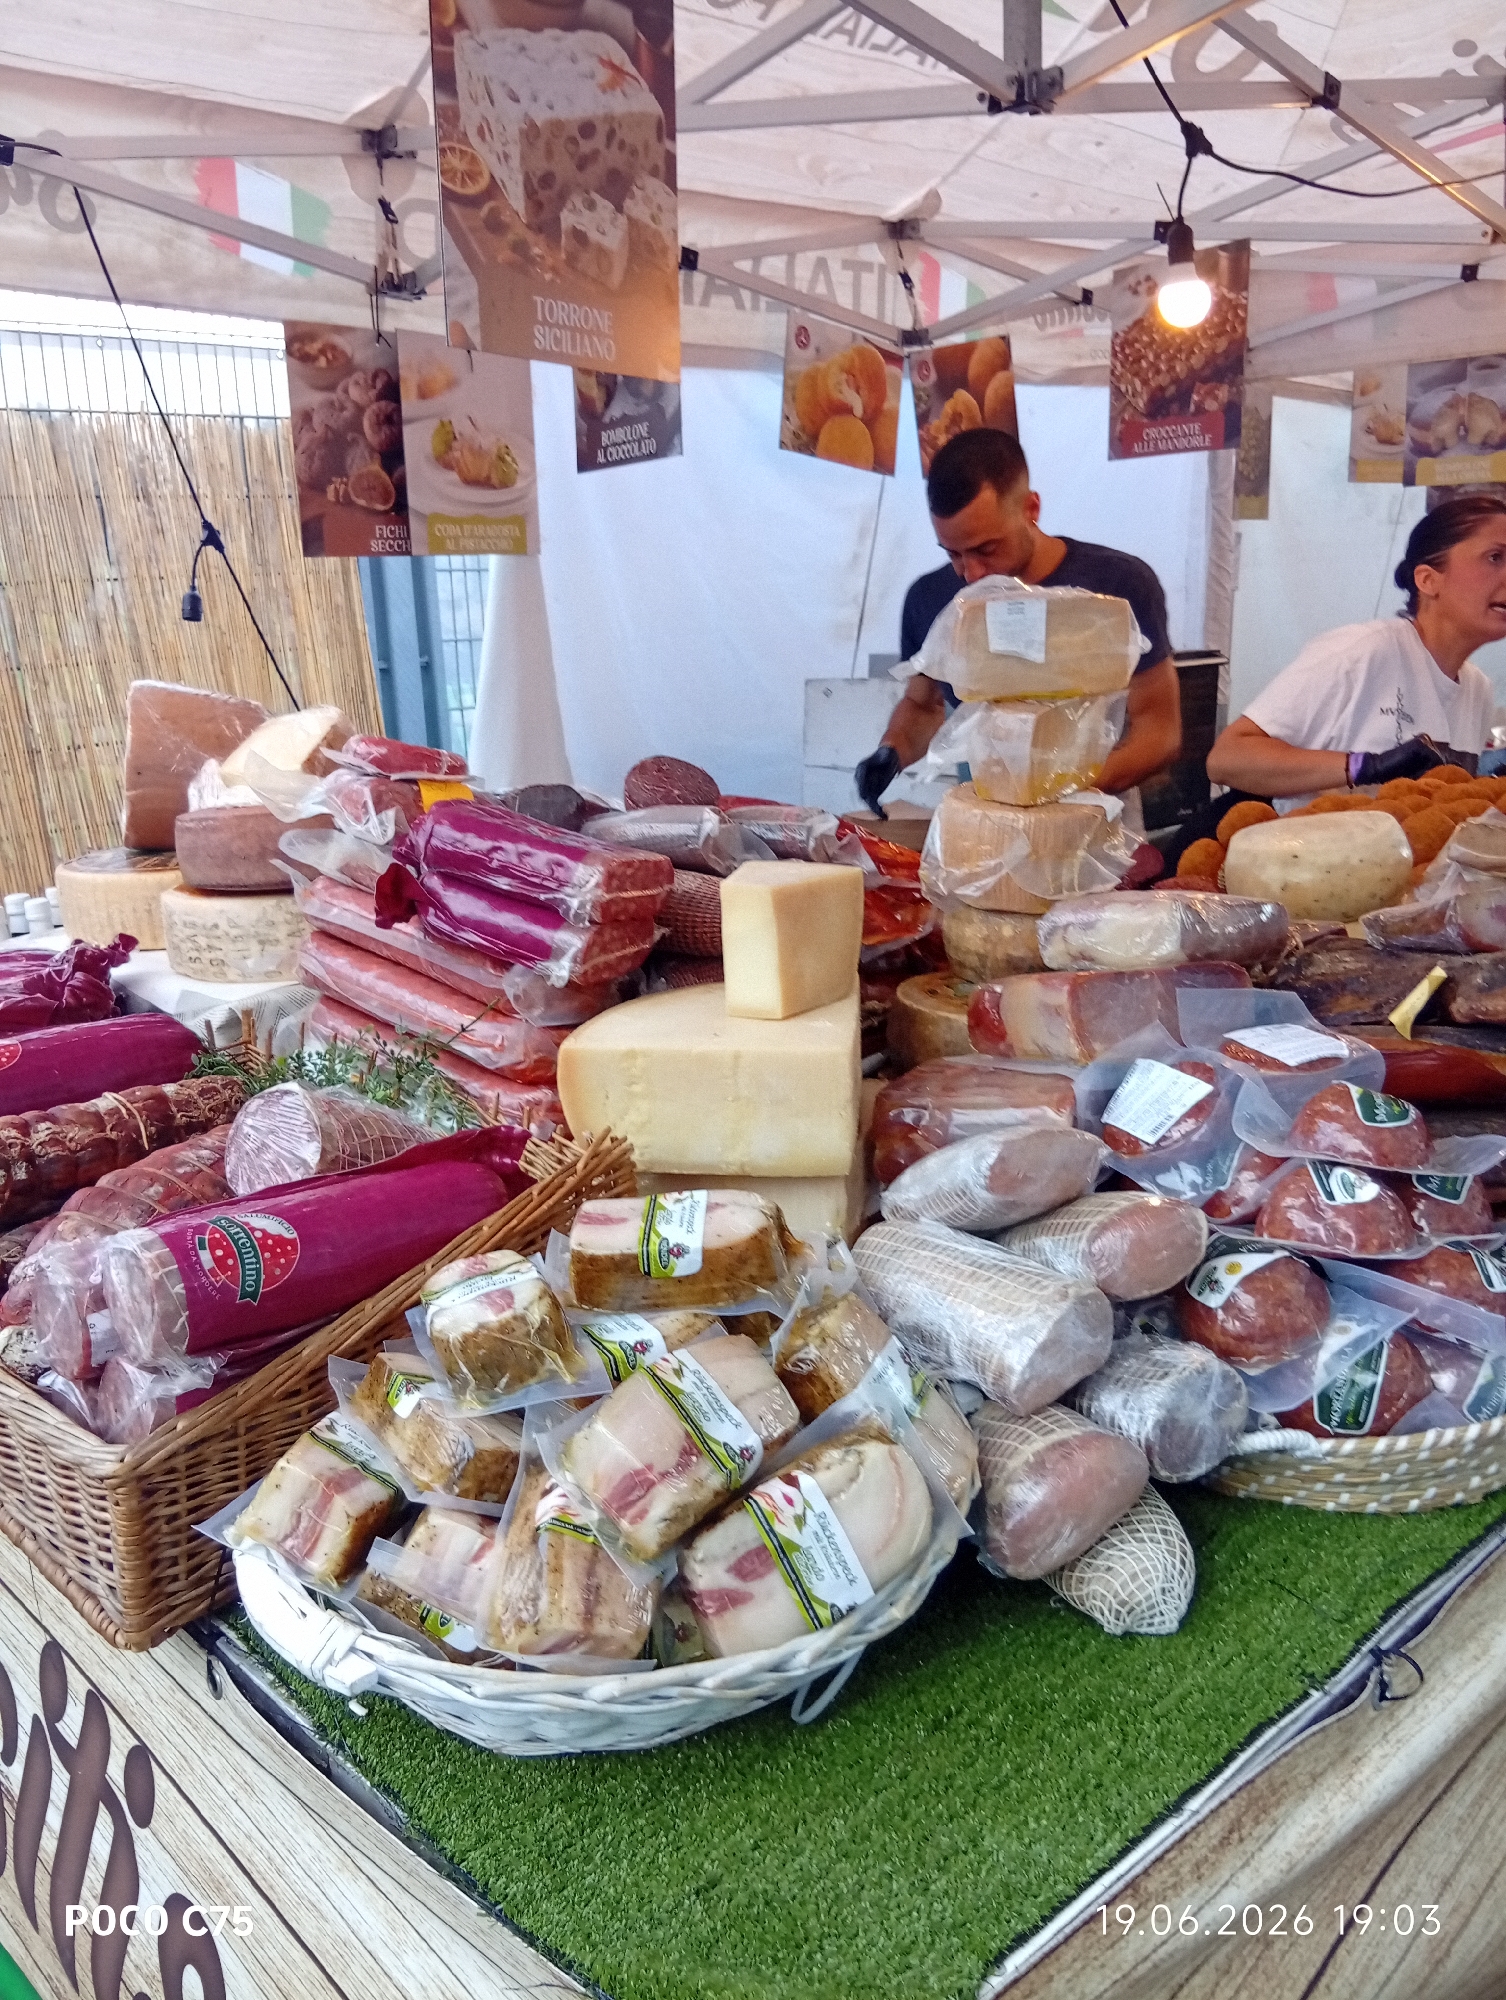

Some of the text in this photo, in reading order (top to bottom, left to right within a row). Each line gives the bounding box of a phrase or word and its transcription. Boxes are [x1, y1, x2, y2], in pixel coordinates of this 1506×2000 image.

[533, 296, 613, 334] TORRONE
[533, 325, 616, 362] SICILIANO
[601, 421, 649, 448] BOMBOLONE
[1142, 422, 1202, 441] CROCCANTE
[597, 437, 657, 464] AL CIOCCOLATO
[370, 539, 412, 552] SECCH
[375, 525, 408, 538] FICHI
[237, 1213, 295, 1235] SALUMIFICIO
[218, 1219, 260, 1292] sorrentino
[195, 1264, 221, 1300] MORDERE
[803, 1546, 825, 1581] Lardo
[814, 1511, 858, 1586] Rückenspeck
